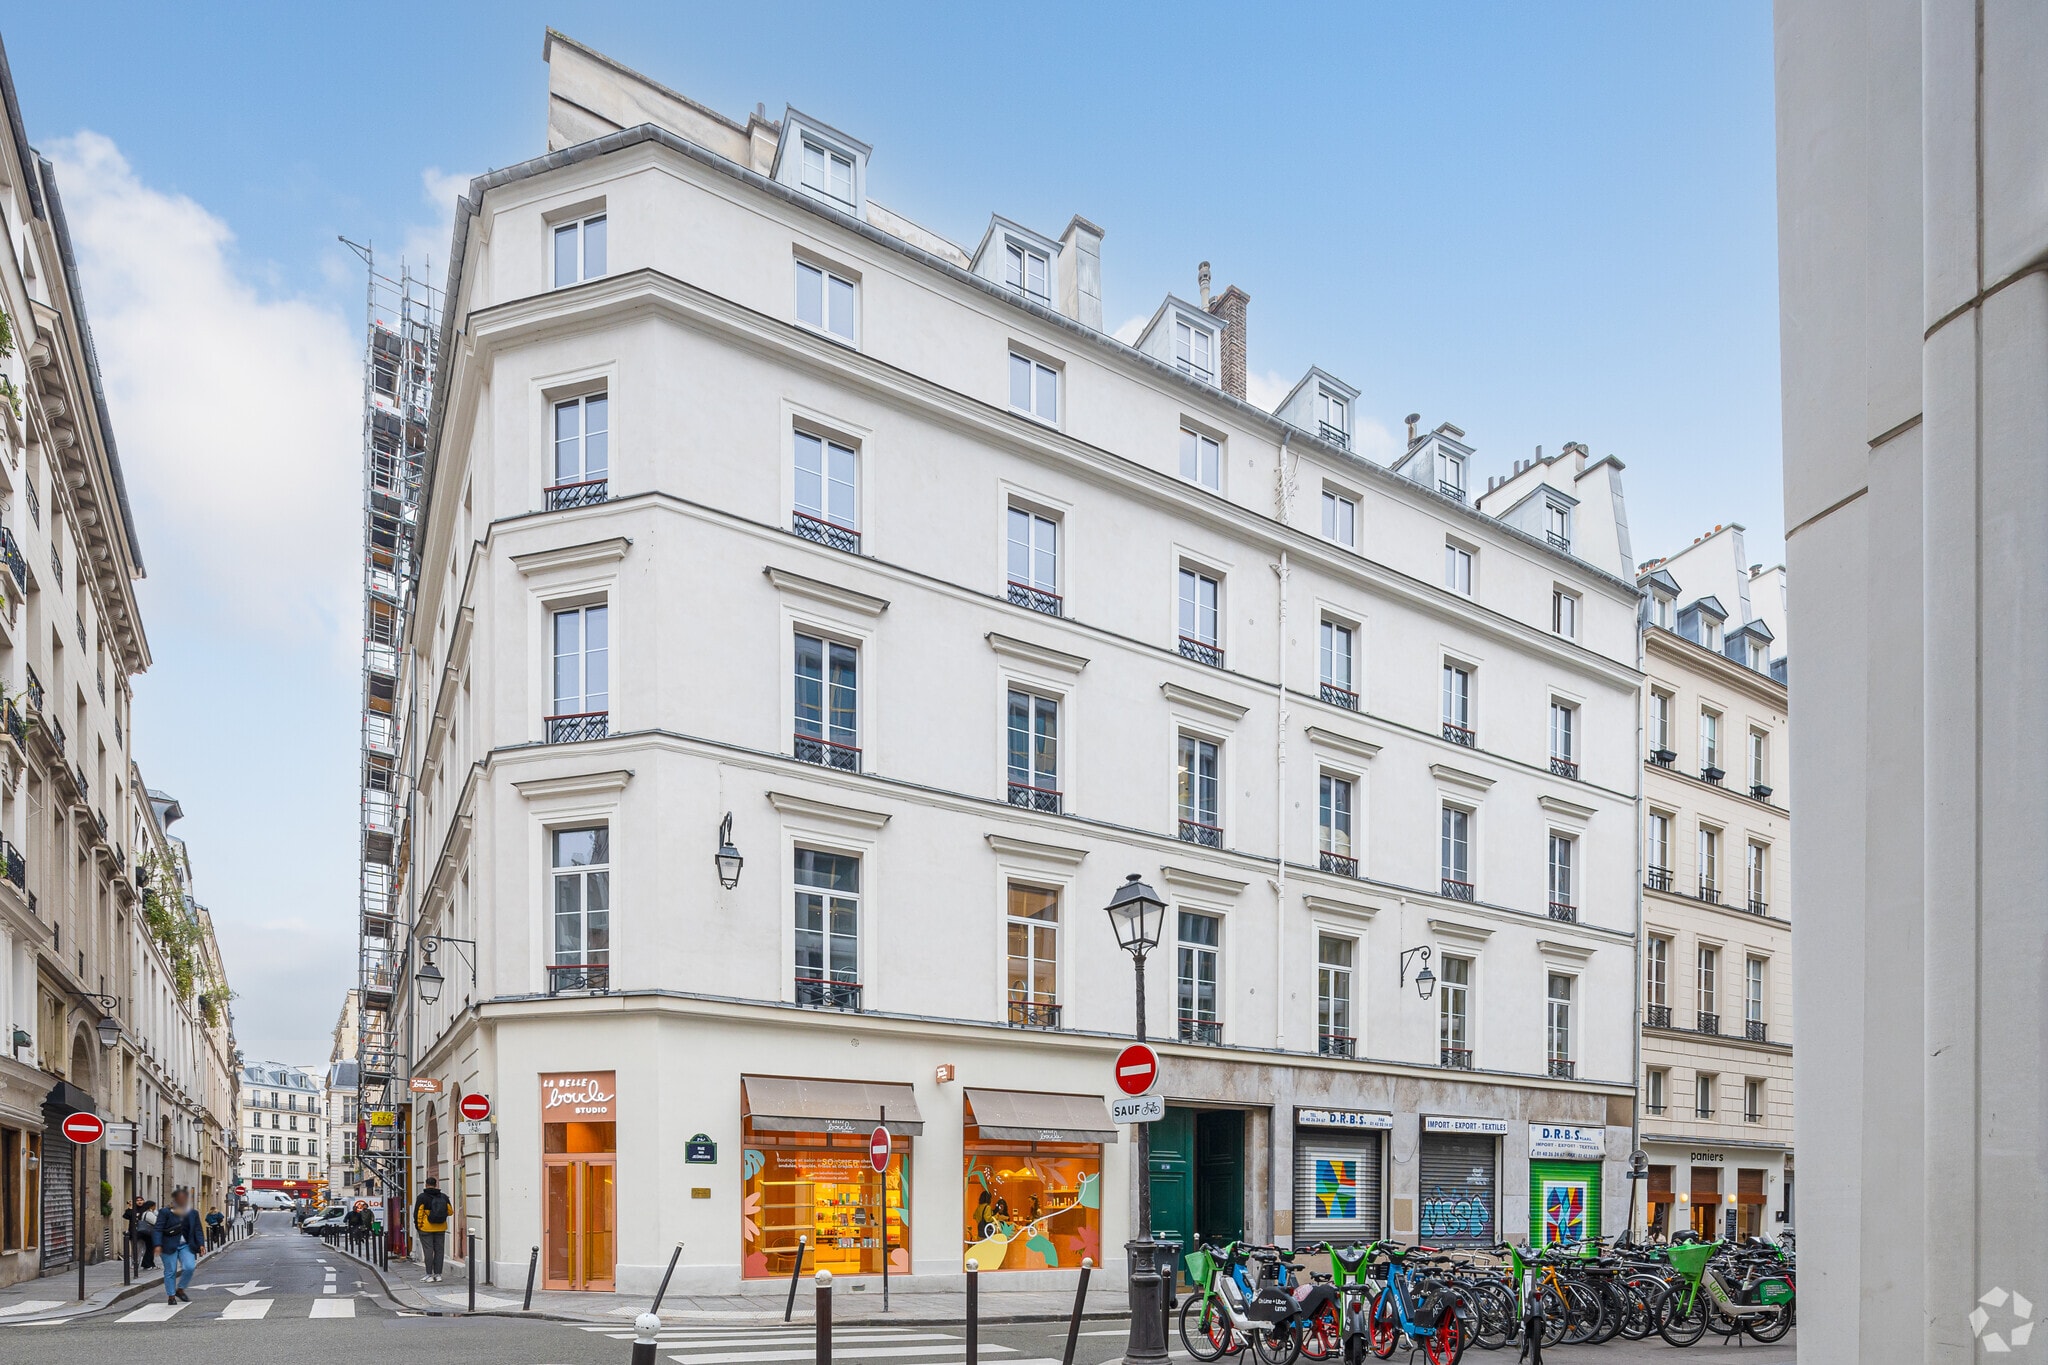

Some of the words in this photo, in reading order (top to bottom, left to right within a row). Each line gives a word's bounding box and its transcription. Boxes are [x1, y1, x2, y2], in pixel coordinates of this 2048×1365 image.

[559, 1078, 588, 1087] BELLE
[545, 1080, 615, 1109] boucle
[1114, 1104, 1140, 1117] SAUF
[1329, 1113, 1367, 1125] D.R.B.S.
[1427, 1120, 1450, 1129] IMPORT
[1455, 1121, 1477, 1130] EXPORT
[1482, 1123, 1506, 1131] TEXTILES
[1690, 1149, 1724, 1163] paniers
[1709, 1280, 1728, 1303] Lime
